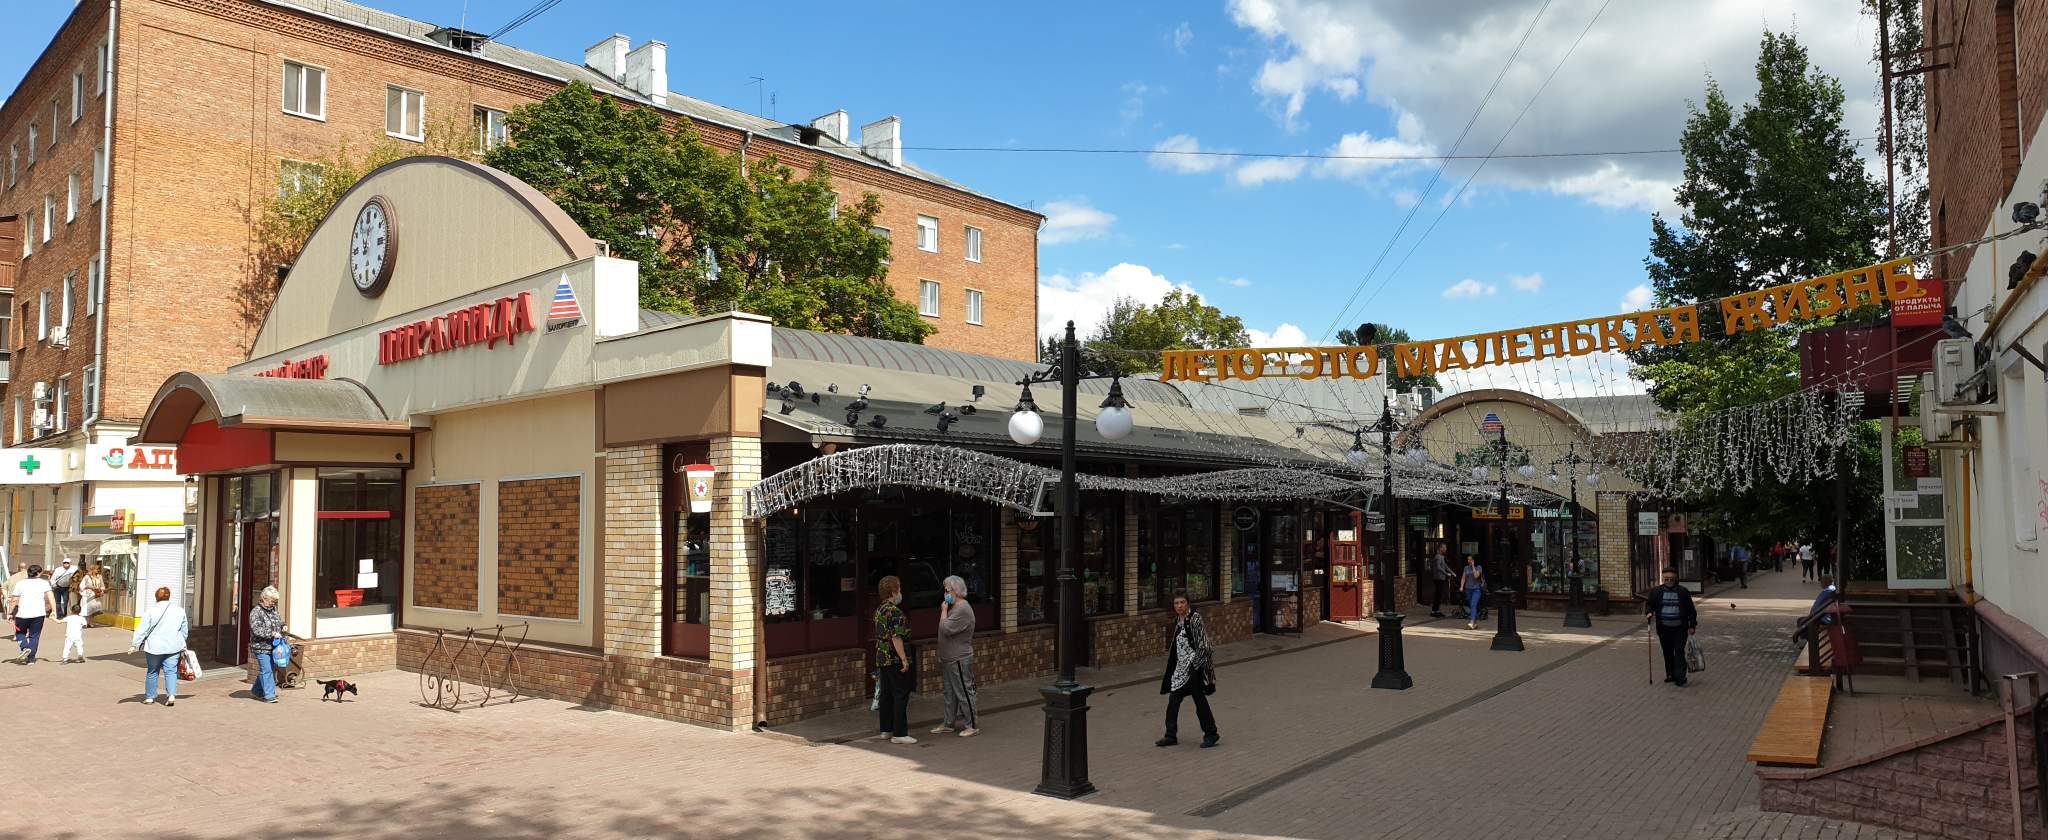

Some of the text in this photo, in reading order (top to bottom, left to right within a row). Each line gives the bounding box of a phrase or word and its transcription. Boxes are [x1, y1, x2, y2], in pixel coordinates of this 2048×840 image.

[1895, 296, 1941, 306] ПРОДУКТЫ
[1906, 303, 1942, 311] ПАЛЫЧА
[378, 290, 536, 366] ПИРАМИДА
[1160, 348, 1265, 383] ЛЕТО
[1298, 347, 1379, 380] ЭТО
[1394, 304, 1702, 379] МАЛЕНЬКАЯ
[128, 447, 177, 470] АП
